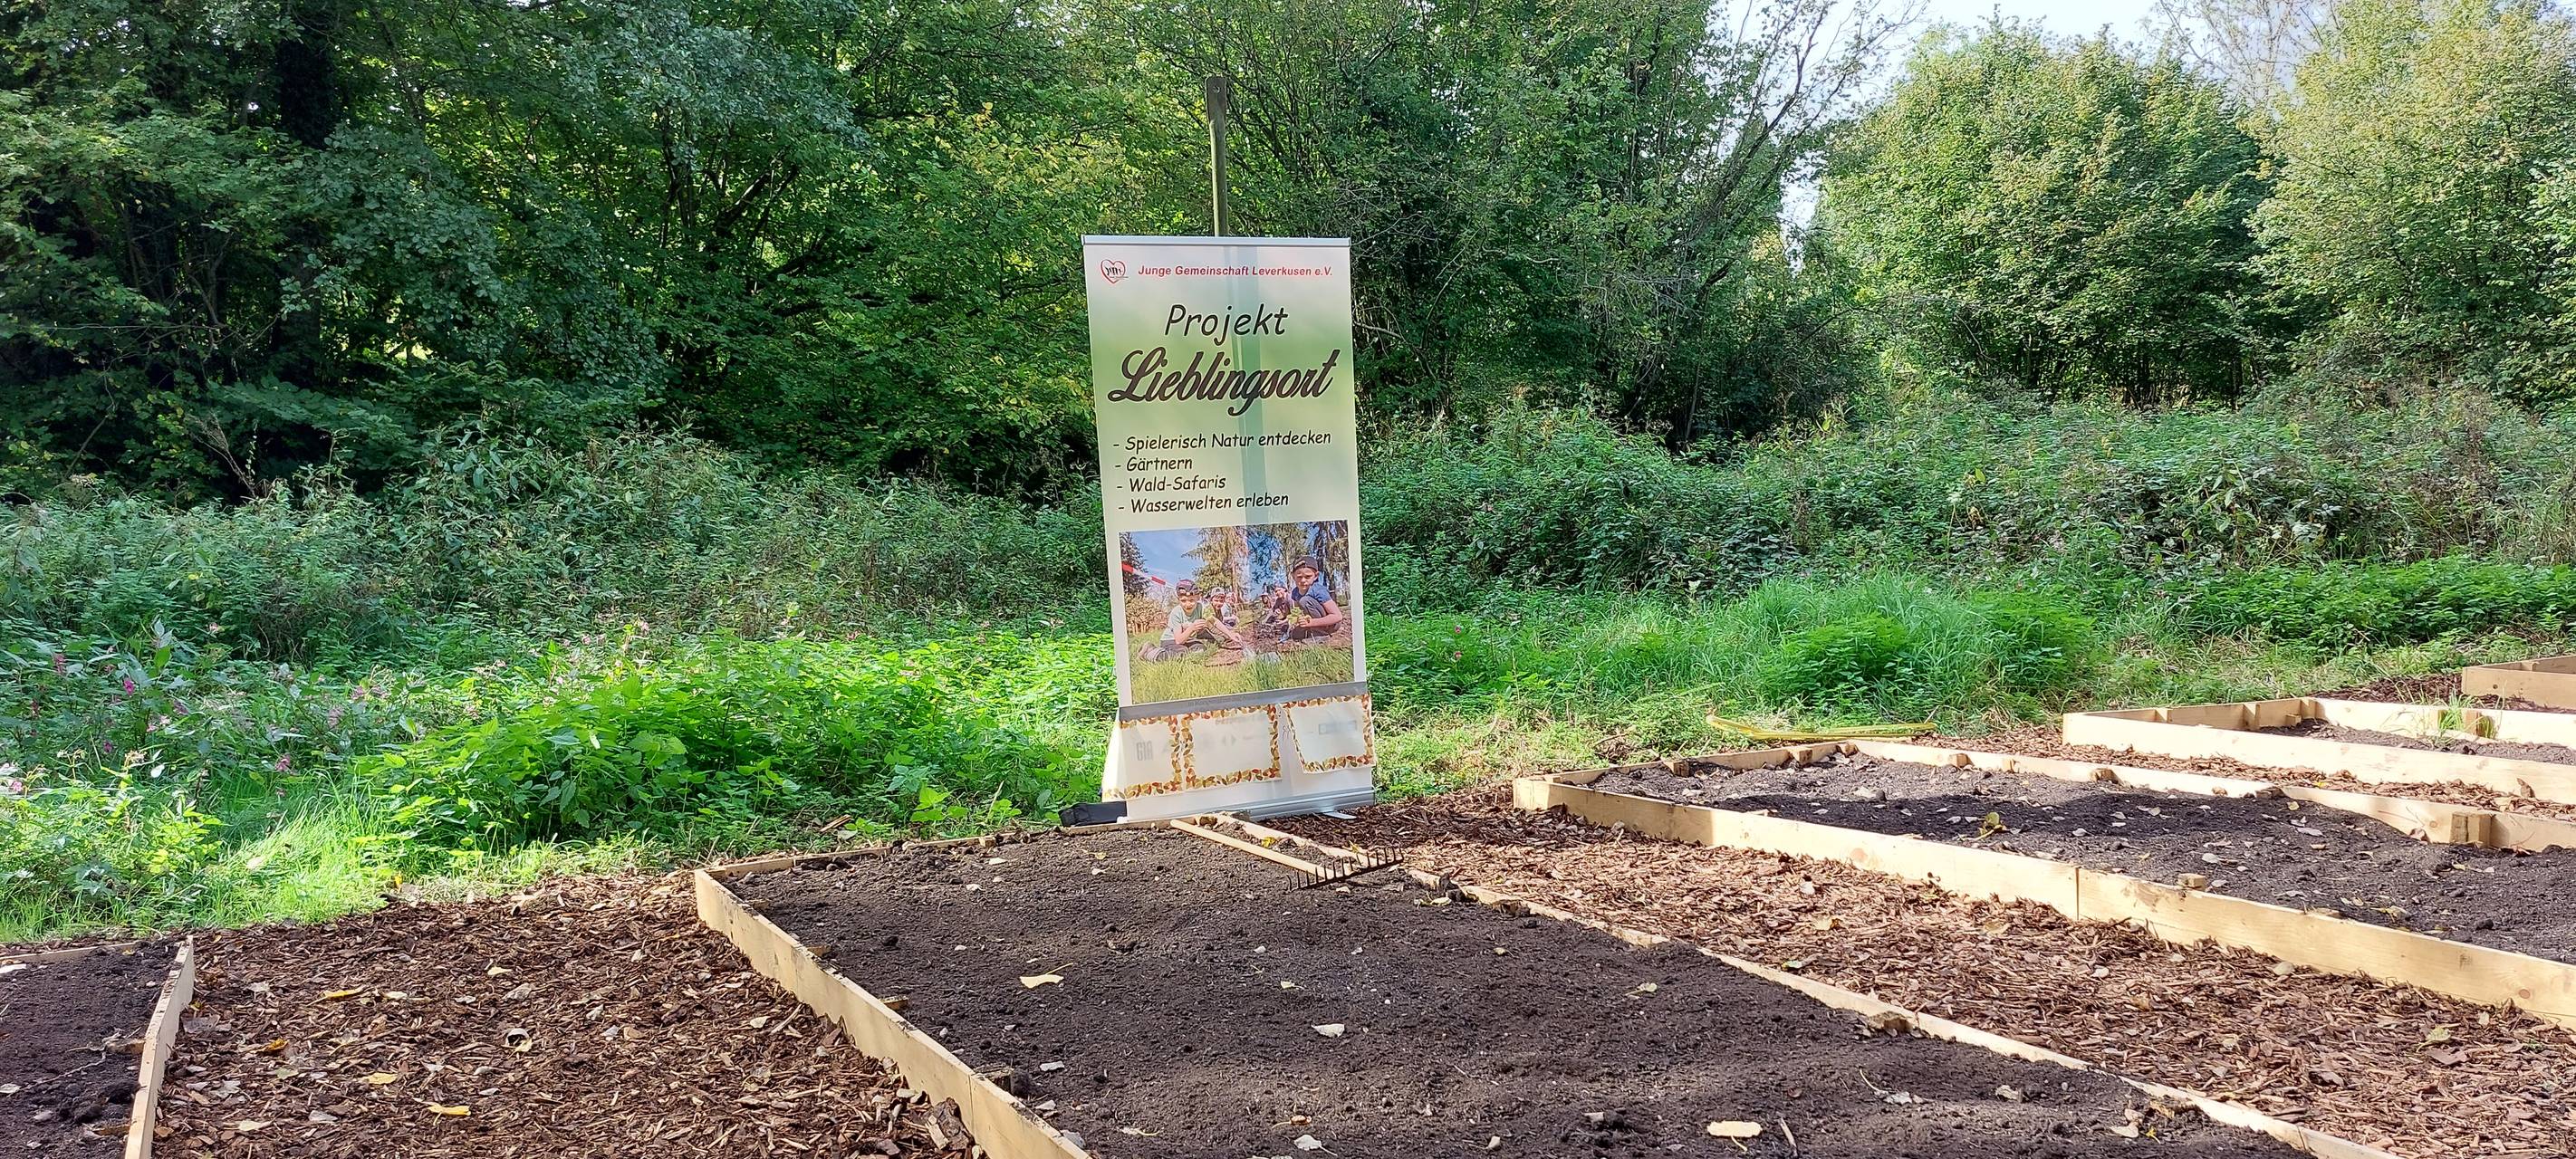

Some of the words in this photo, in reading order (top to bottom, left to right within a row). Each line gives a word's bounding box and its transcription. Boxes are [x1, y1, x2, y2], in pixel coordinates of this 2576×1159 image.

[1138, 265, 1172, 277] Junge
[1175, 265, 1249, 275] Gemeinschaft
[1252, 265, 1312, 276] Leverkusen
[1314, 267, 1333, 276] e.V.
[1165, 303, 1289, 346] Projekt
[1107, 346, 1341, 416] Lieblingsort
[1125, 433, 1206, 454] Spielerisch
[1211, 432, 1254, 447] Natur
[1258, 429, 1331, 446] entdecken
[1126, 455, 1193, 471] Gärtnern
[1129, 475, 1226, 493] Wald-Safaris
[1130, 494, 1232, 513] Wasserwelten
[1235, 492, 1289, 508] erleben
